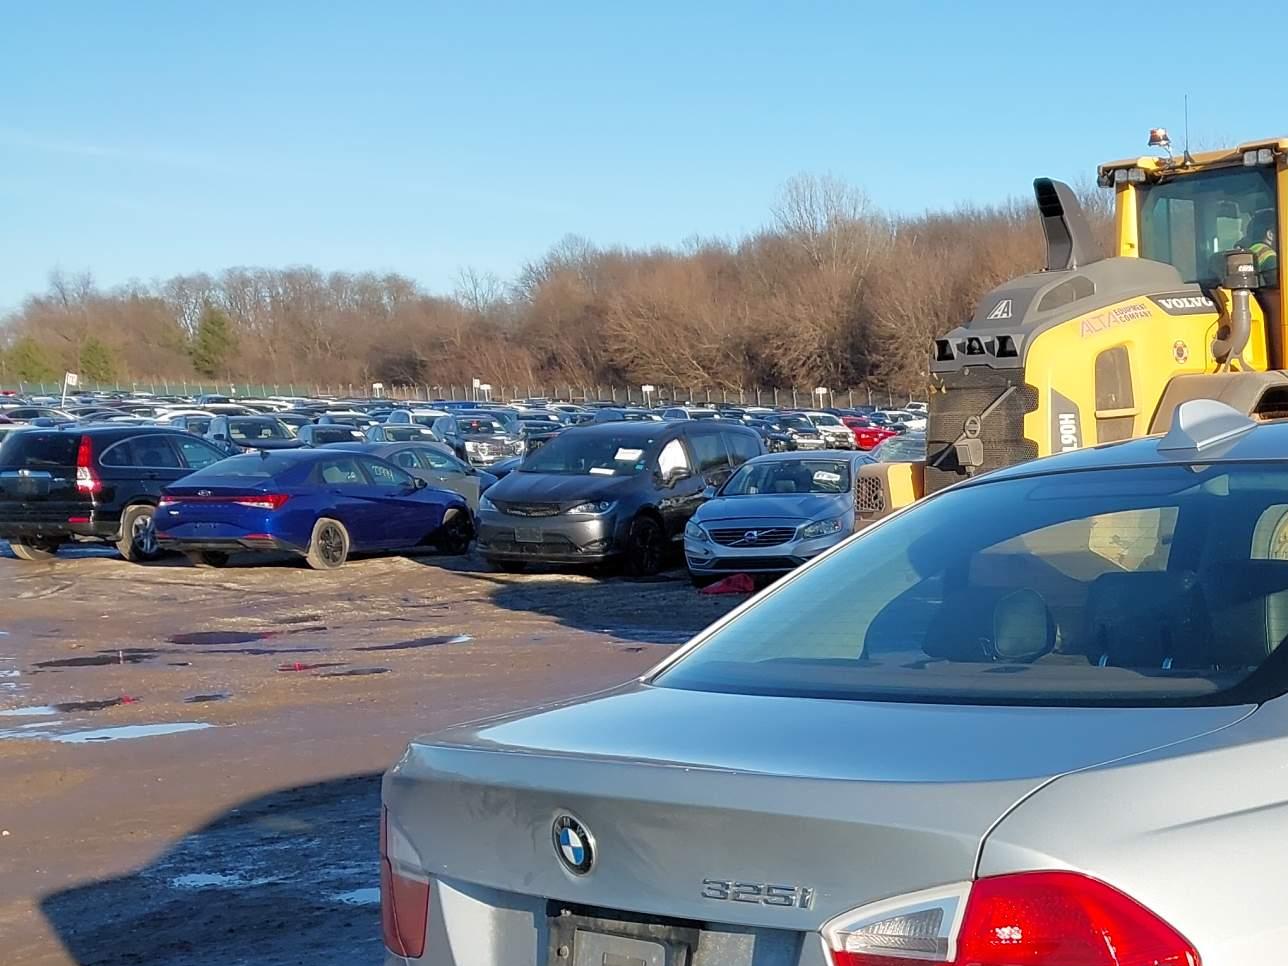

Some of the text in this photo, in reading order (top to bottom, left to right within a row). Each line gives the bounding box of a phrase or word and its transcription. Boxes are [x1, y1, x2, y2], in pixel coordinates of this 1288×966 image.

[1079, 303, 1147, 338] ALTA EQUIPMENT
[1119, 310, 1153, 323] COMPANY
[700, 878, 816, 912] 325i
